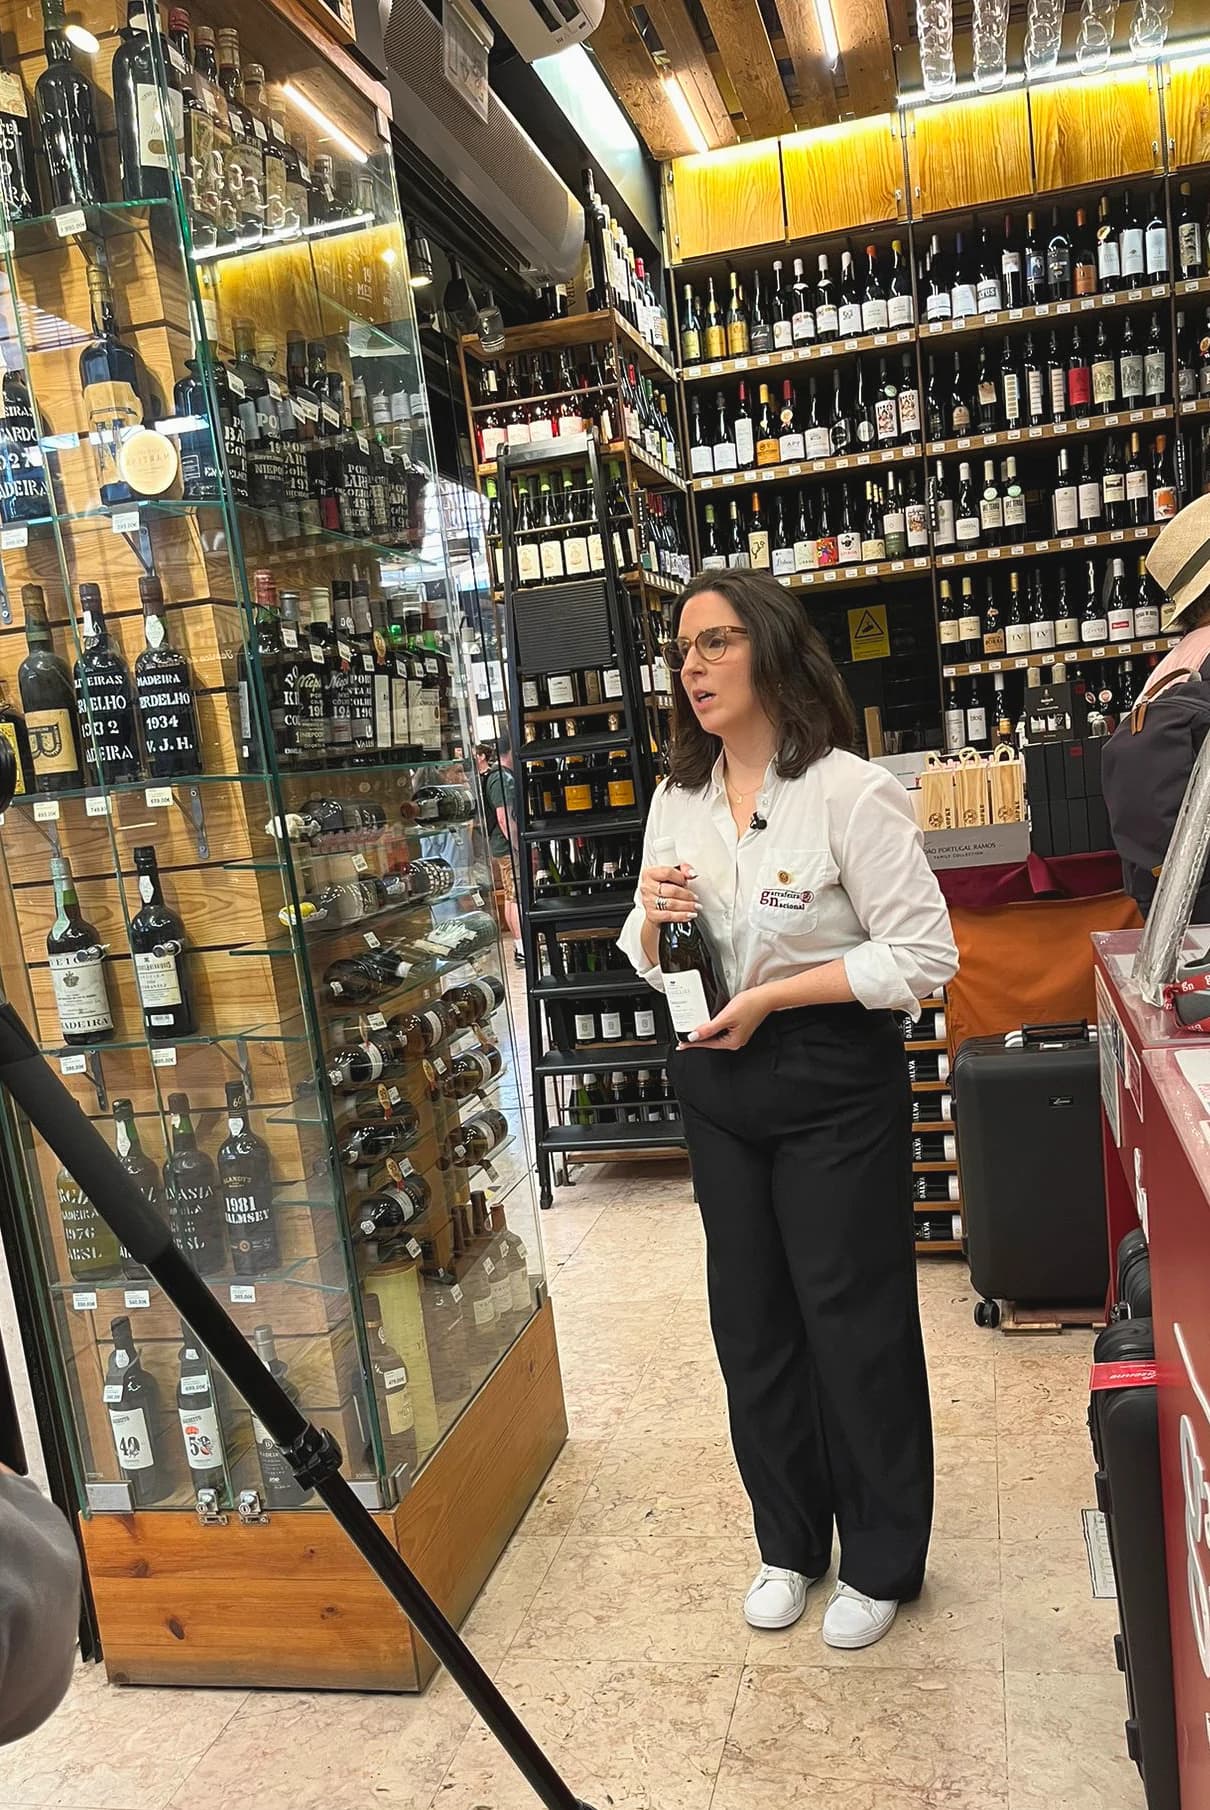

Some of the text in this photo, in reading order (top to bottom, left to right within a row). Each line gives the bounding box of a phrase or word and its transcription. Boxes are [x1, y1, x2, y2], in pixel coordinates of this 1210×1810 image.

[146, 714, 179, 731] 1934
[938, 844, 971, 854] PORTUGAL
[974, 841, 997, 851] RAMOS
[224, 1196, 256, 1213] 1981
